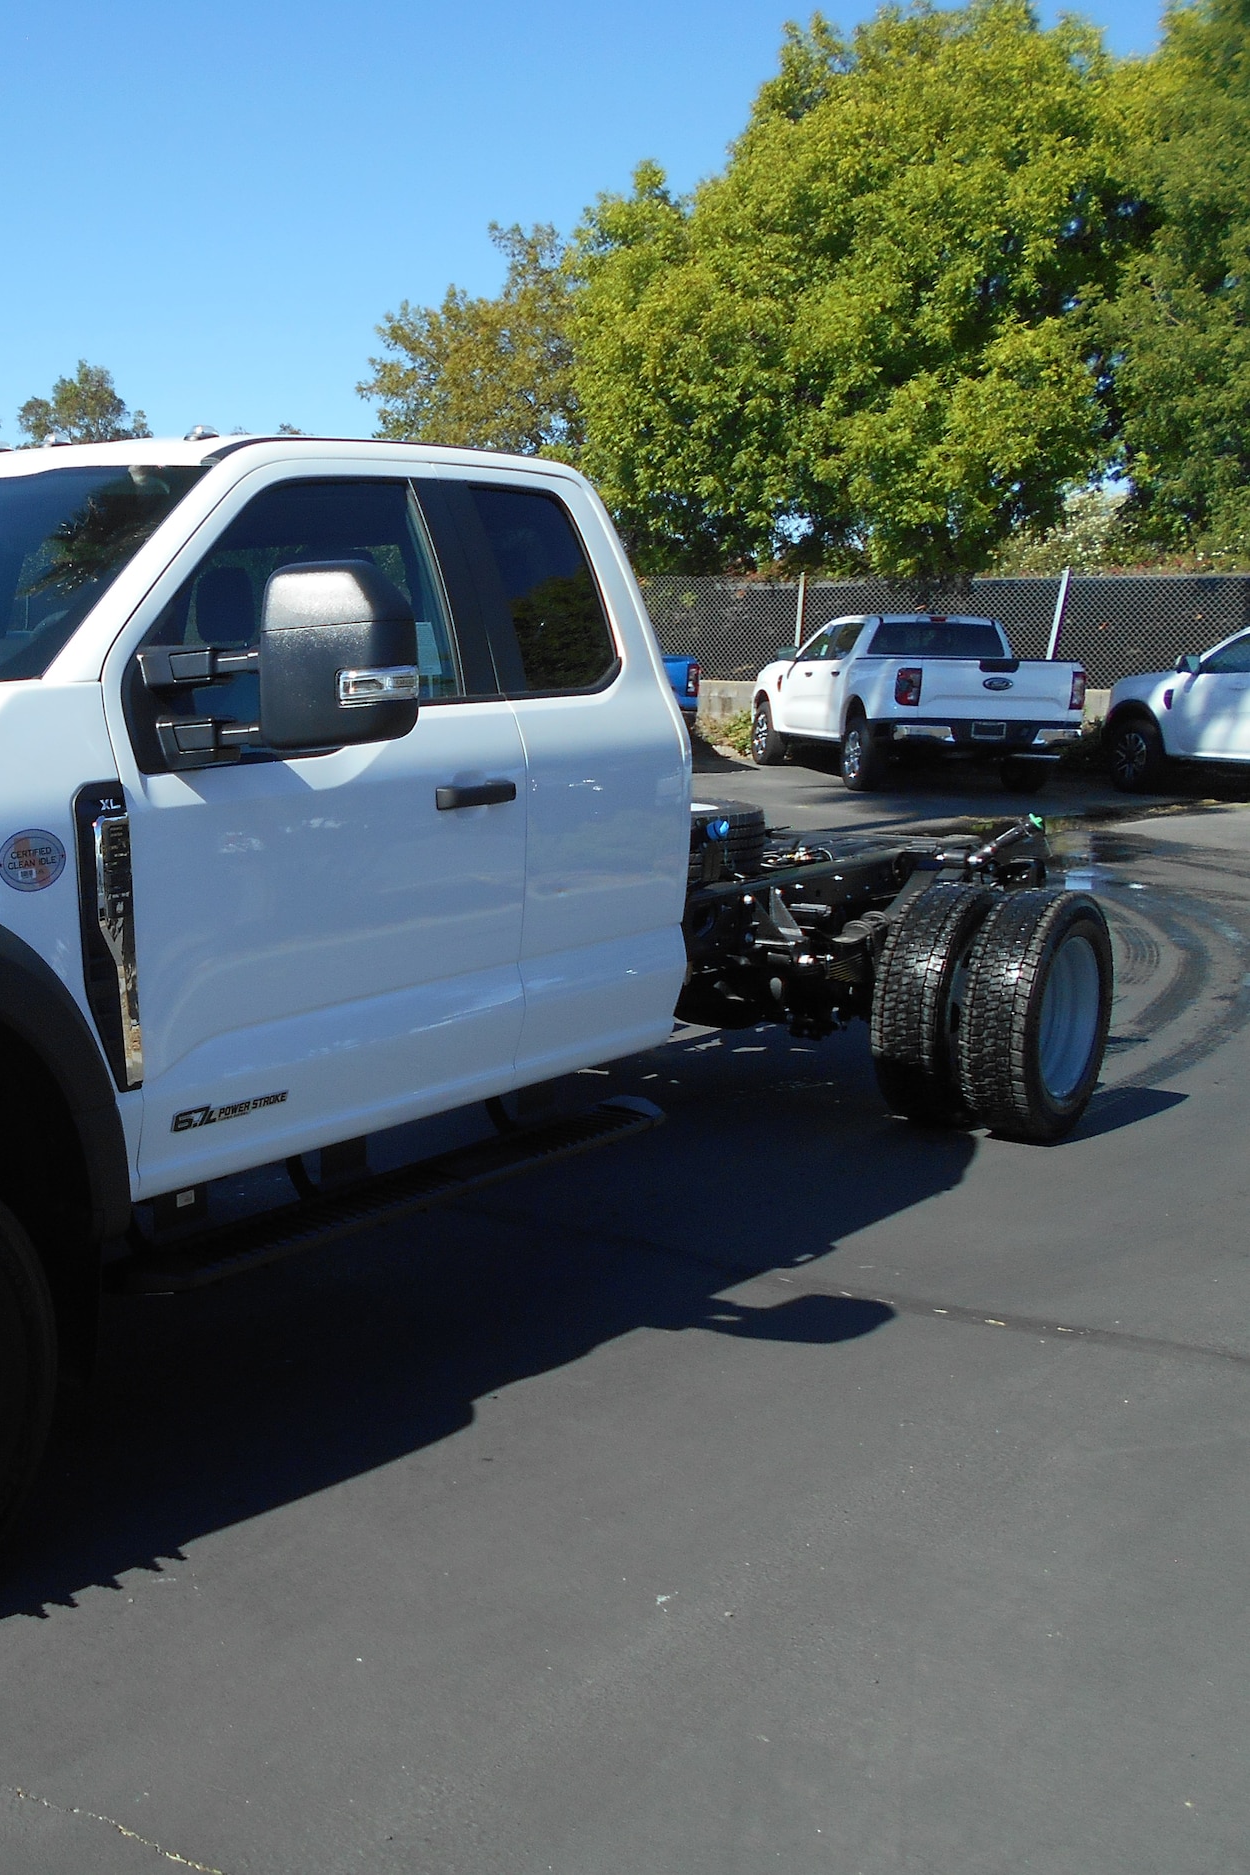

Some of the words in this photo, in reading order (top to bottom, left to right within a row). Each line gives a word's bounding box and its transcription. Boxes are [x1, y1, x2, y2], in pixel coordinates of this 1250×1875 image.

[100, 799, 121, 810] XL
[10, 846, 52, 860] CERTIFIED
[7, 859, 36, 870] CLEAN
[39, 856, 57, 866] IDLE
[218, 1101, 251, 1118] POWER
[252, 1092, 287, 1109] STROKE
